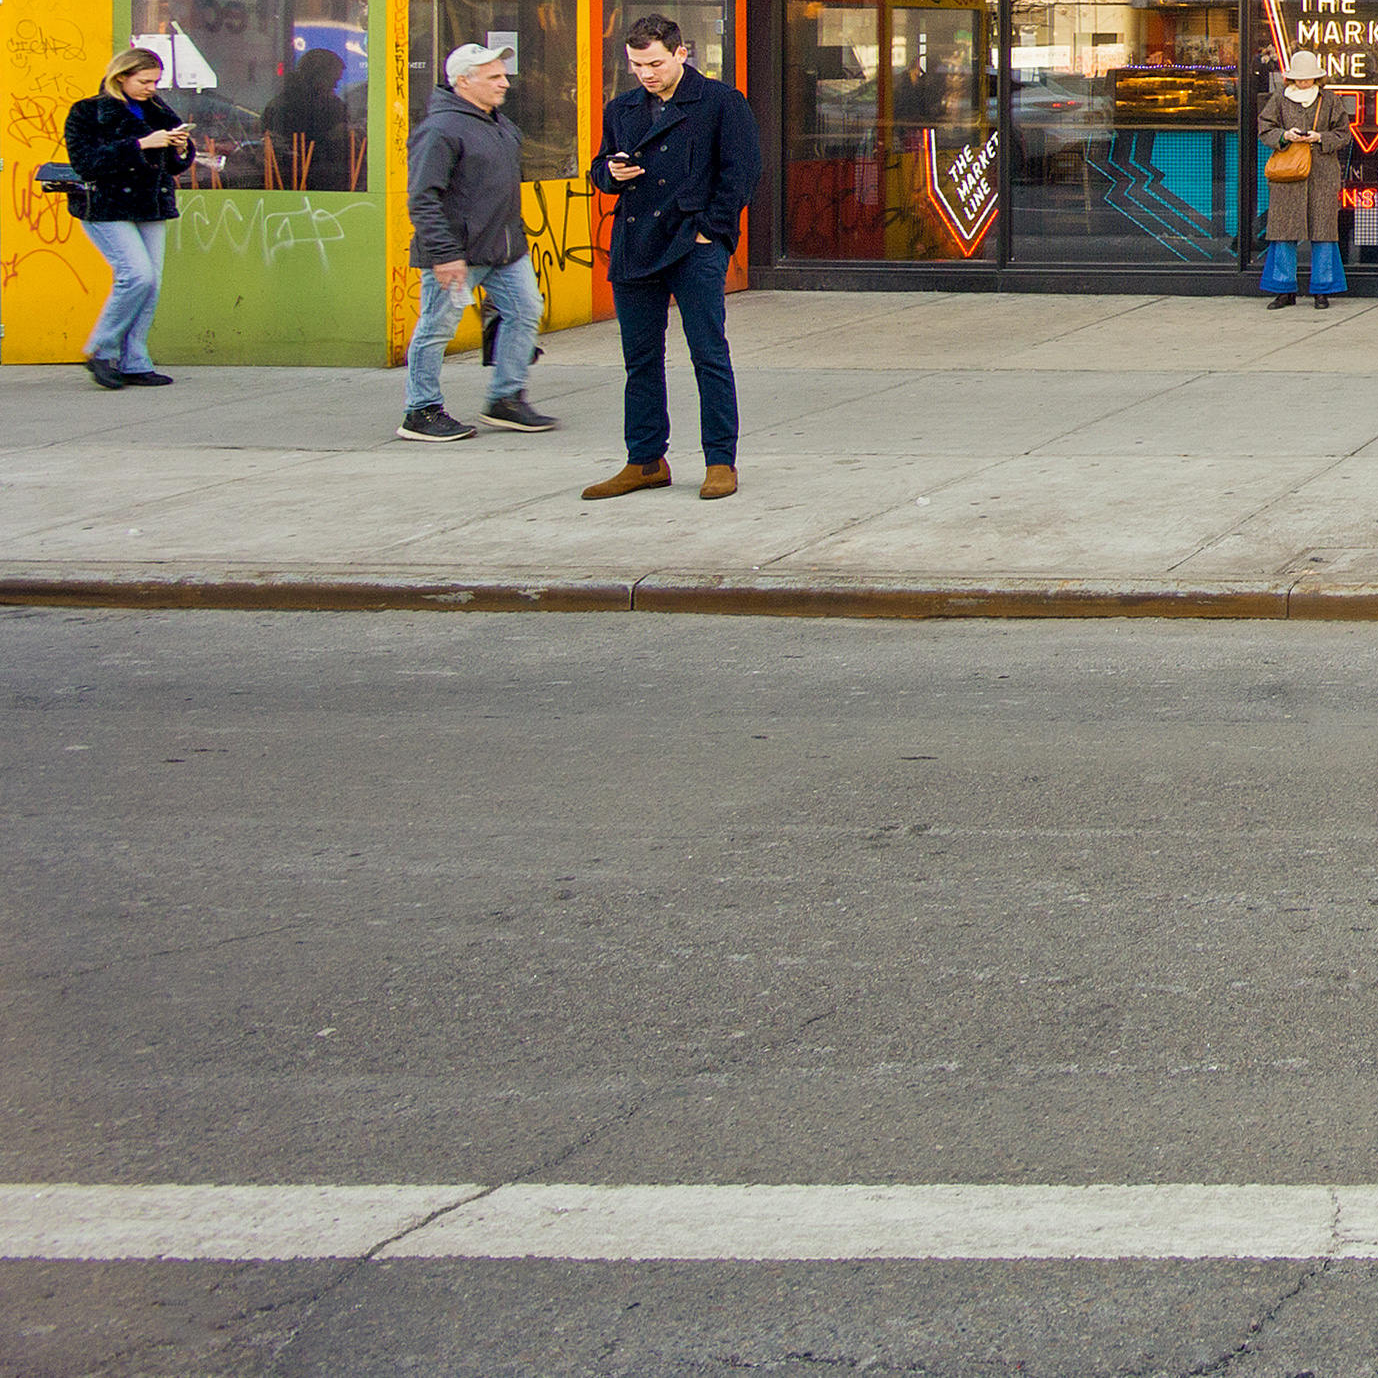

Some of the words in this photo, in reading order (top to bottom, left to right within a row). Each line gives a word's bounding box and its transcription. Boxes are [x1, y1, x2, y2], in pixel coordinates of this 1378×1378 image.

[1316, 53, 1367, 78] INE
[948, 144, 975, 183] THE
[956, 131, 999, 202] MARKET
[963, 177, 992, 221] LINE
